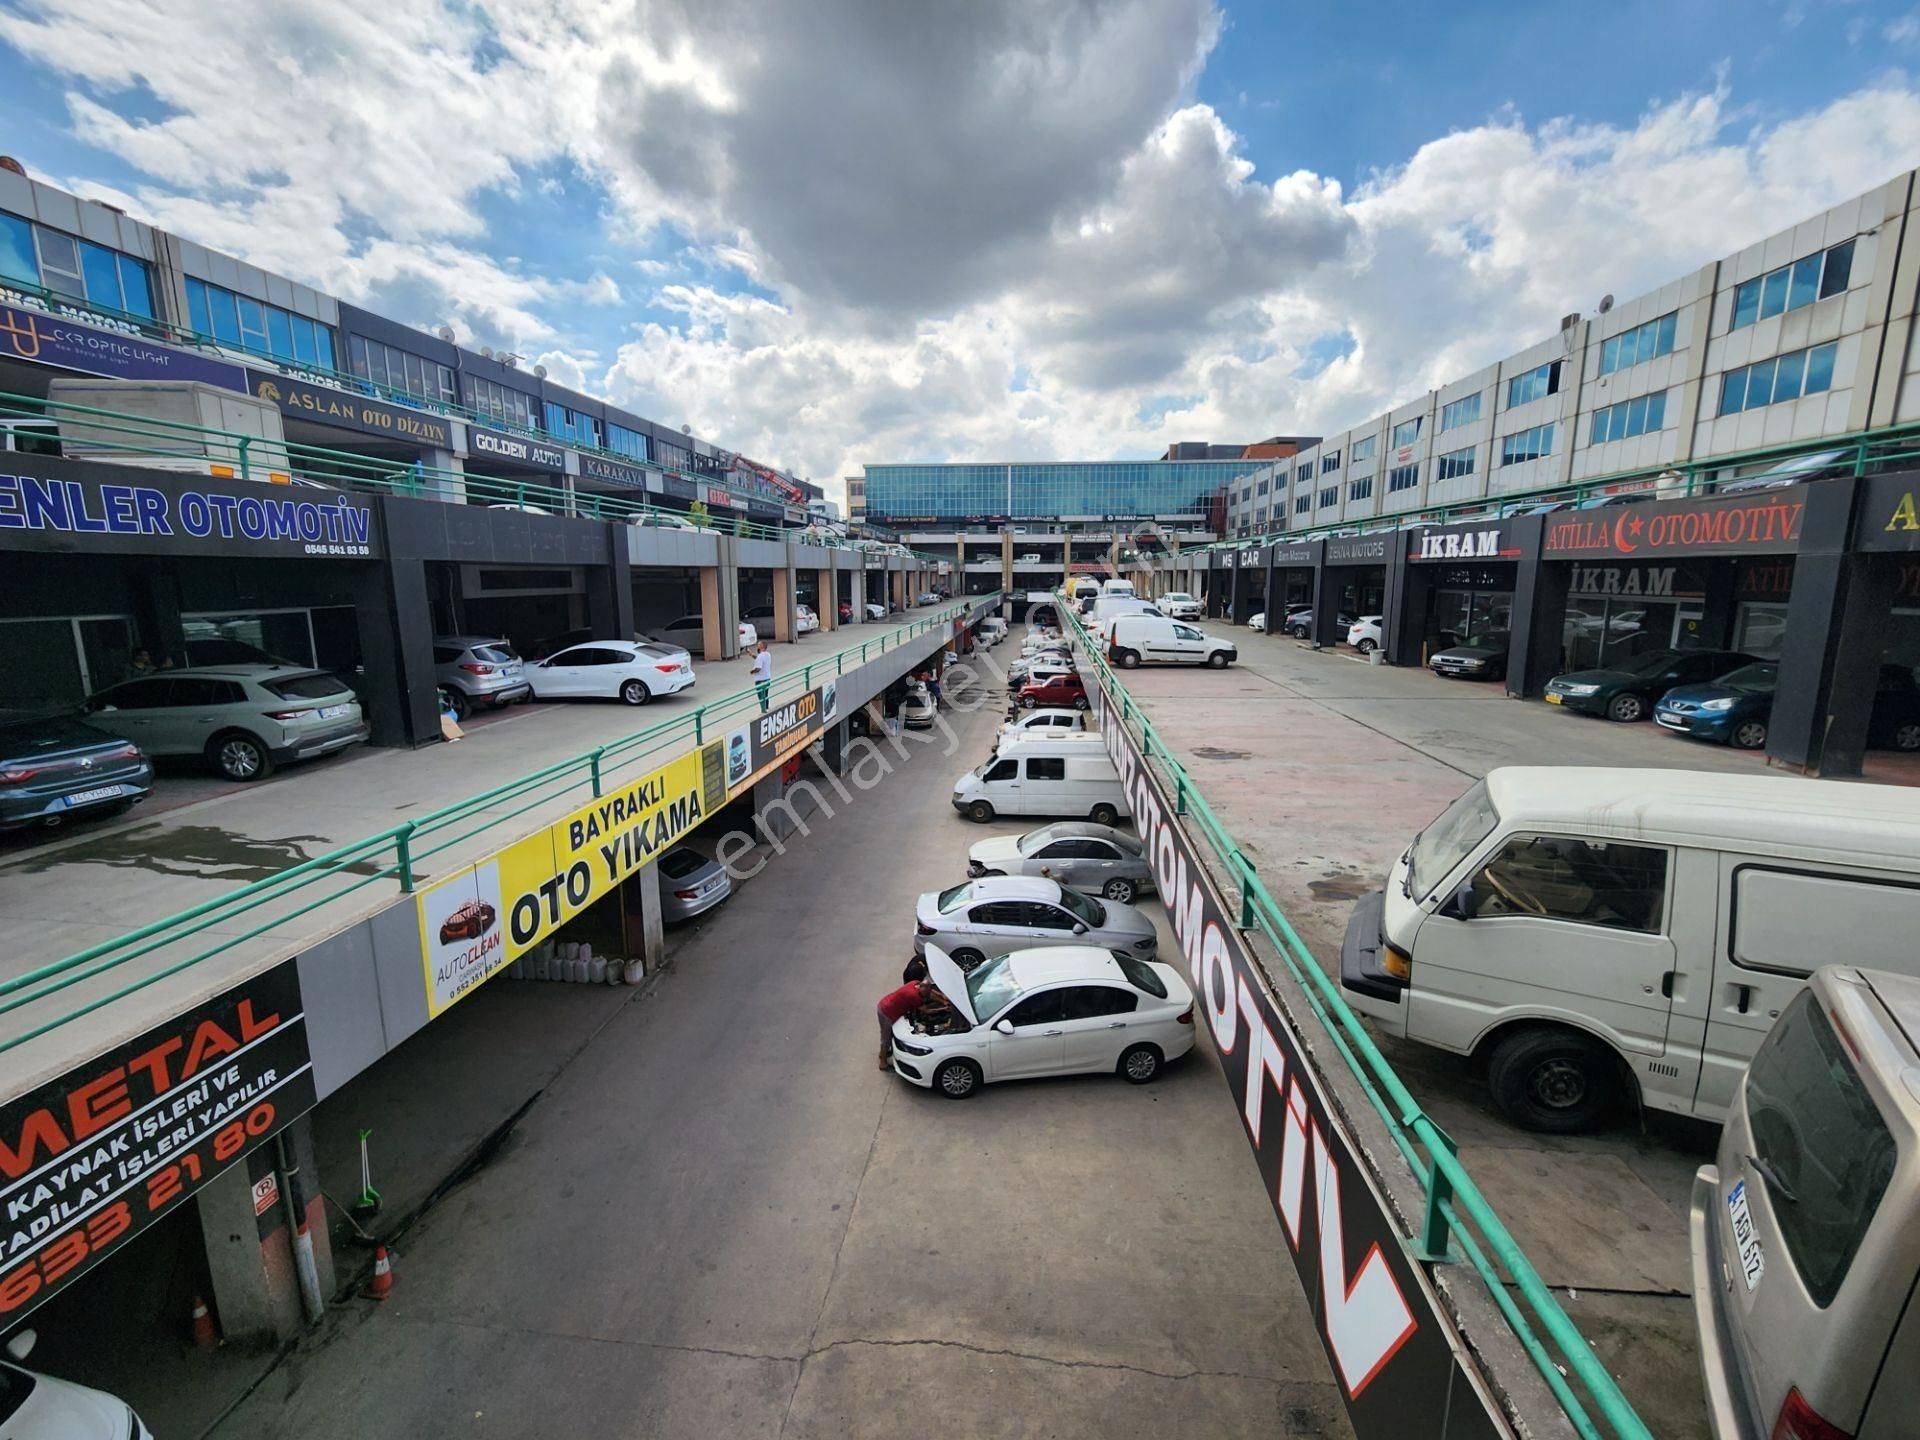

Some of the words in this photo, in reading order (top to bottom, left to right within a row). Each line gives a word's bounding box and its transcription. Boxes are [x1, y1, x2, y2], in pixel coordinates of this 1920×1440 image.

[288, 392, 355, 419] ASLAN
[362, 409, 392, 428] OTO
[397, 416, 445, 441] DİZAYN
[475, 433, 527, 460] GOLDEN
[532, 451, 562, 467] AUTO
[586, 460, 644, 486] KARAKAYA
[178, 492, 370, 543] OTOMOTİV
[1546, 516, 1609, 550] ATİLLA
[1648, 495, 1802, 546] OTOMOTİV
[304, 544, 327, 554] 0545
[1222, 553, 1233, 567] MS
[1241, 551, 1259, 566] CAR
[1420, 529, 1501, 559] İKRAM
[1568, 562, 1677, 594] İKRAM
[760, 702, 797, 743] ENSAR
[798, 693, 816, 720] OTO
[569, 776, 665, 851] BAYRAKLI
[510, 860, 591, 946] OTO
[600, 789, 702, 882] YIKAMA
[0, 998, 280, 1178] METAL
[1136, 773, 1417, 1400] OTOMOTİV
[8, 1132, 131, 1221] KAYNAK
[133, 1080, 210, 1143] İŞLERİ
[212, 1064, 241, 1092] VE
[118, 1117, 195, 1181] İŞLERİ
[199, 1068, 278, 1127] YAPILIR
[0, 1200, 132, 1313] 633
[147, 1152, 203, 1212] 21
[213, 1102, 276, 1161] 80
